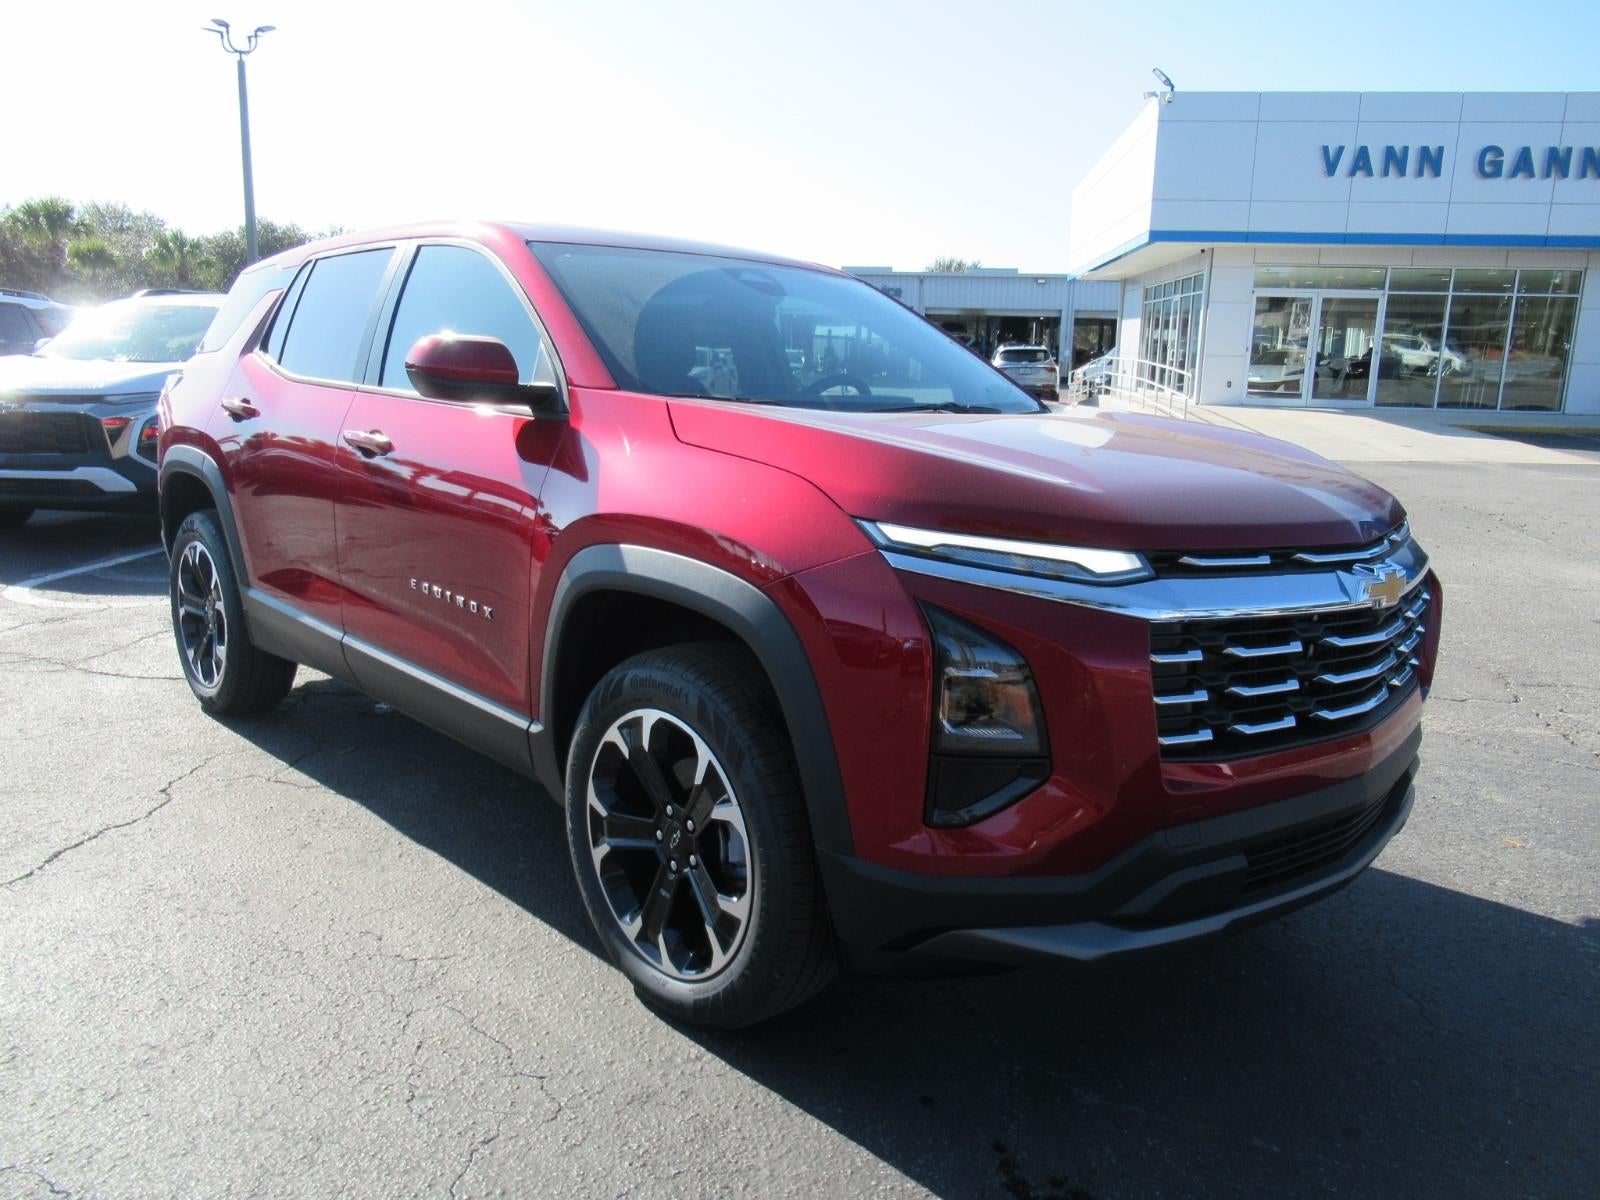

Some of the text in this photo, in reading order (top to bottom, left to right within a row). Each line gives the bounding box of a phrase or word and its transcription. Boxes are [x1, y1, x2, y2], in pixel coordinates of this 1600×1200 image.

[1321, 145, 1600, 179] VANN GANN
[410, 577, 494, 620] EQUINOX
[630, 674, 684, 702] Continental
